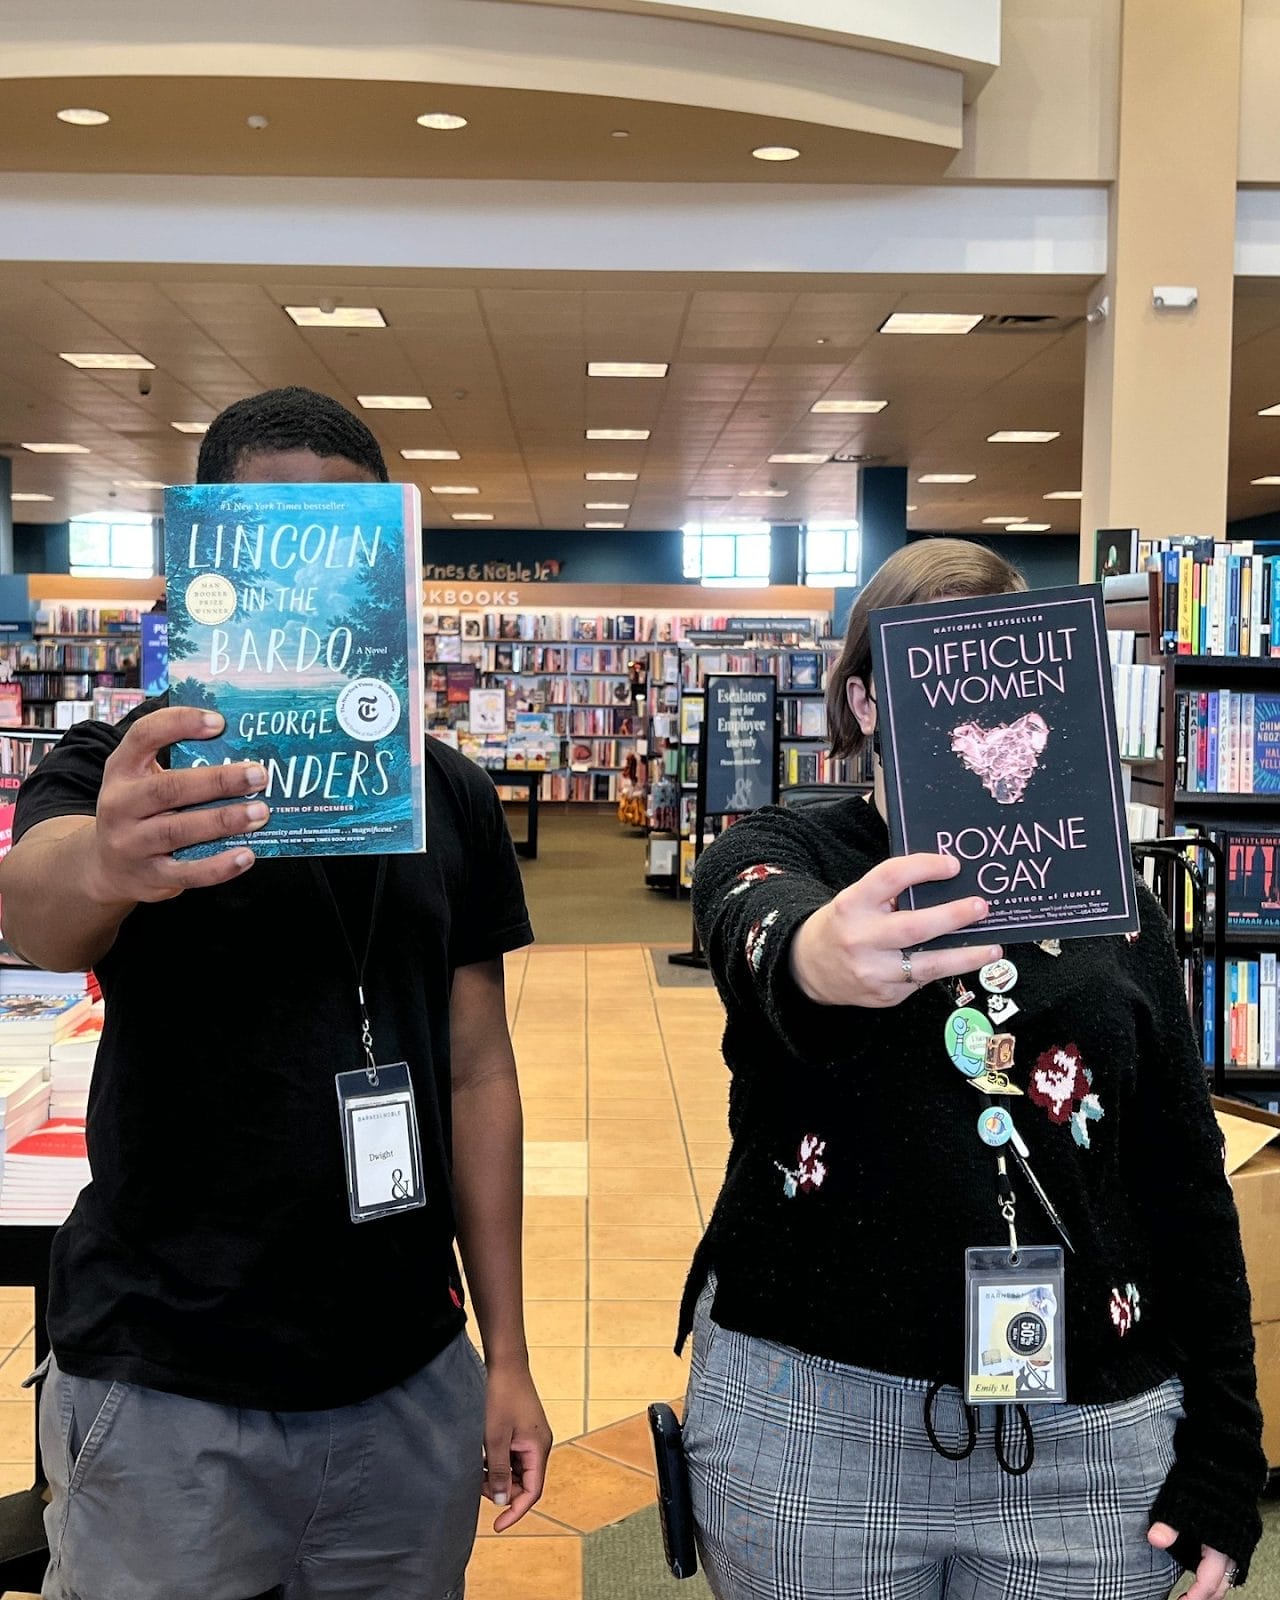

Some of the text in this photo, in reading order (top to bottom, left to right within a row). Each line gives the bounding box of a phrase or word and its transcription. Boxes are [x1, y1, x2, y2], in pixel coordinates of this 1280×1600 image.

[234, 502, 251, 511] New
[255, 502, 274, 511] York
[277, 502, 302, 511] Times
[303, 502, 345, 511] bestseller
[188, 524, 382, 569] LINCOLN
[422, 563, 465, 580] rnes
[467, 562, 481, 580] &
[483, 561, 531, 582] Noble
[242, 587, 319, 612] IN THE
[423, 590, 520, 605] KBOOKS
[933, 615, 1044, 635] NATIONAL BESTSELLER
[210, 627, 353, 675] BARDO
[356, 646, 388, 655] A Novel
[907, 627, 1078, 680] DIFFICULT
[717, 688, 767, 703] Escalators
[921, 666, 1066, 709] WOMEN
[239, 708, 333, 741] GEORGE
[717, 716, 766, 736] Employee
[1259, 721, 1280, 731] CHIM
[1257, 732, 1280, 742] NGOZ
[1265, 748, 1280, 758] HAL
[1260, 759, 1280, 769] YELL
[191, 750, 395, 800] NDERS
[314, 805, 354, 813] DECEMBER
[936, 816, 1087, 860] ROXANE
[977, 857, 1053, 895] GAY
[1005, 895, 1043, 904] AUTHOR
[1062, 889, 1102, 899] HUNGER
[1264, 918, 1280, 926] ALA
[368, 1149, 394, 1162] Dwight
[391, 1168, 410, 1200] &
[975, 1384, 1010, 1393] Emily M.
